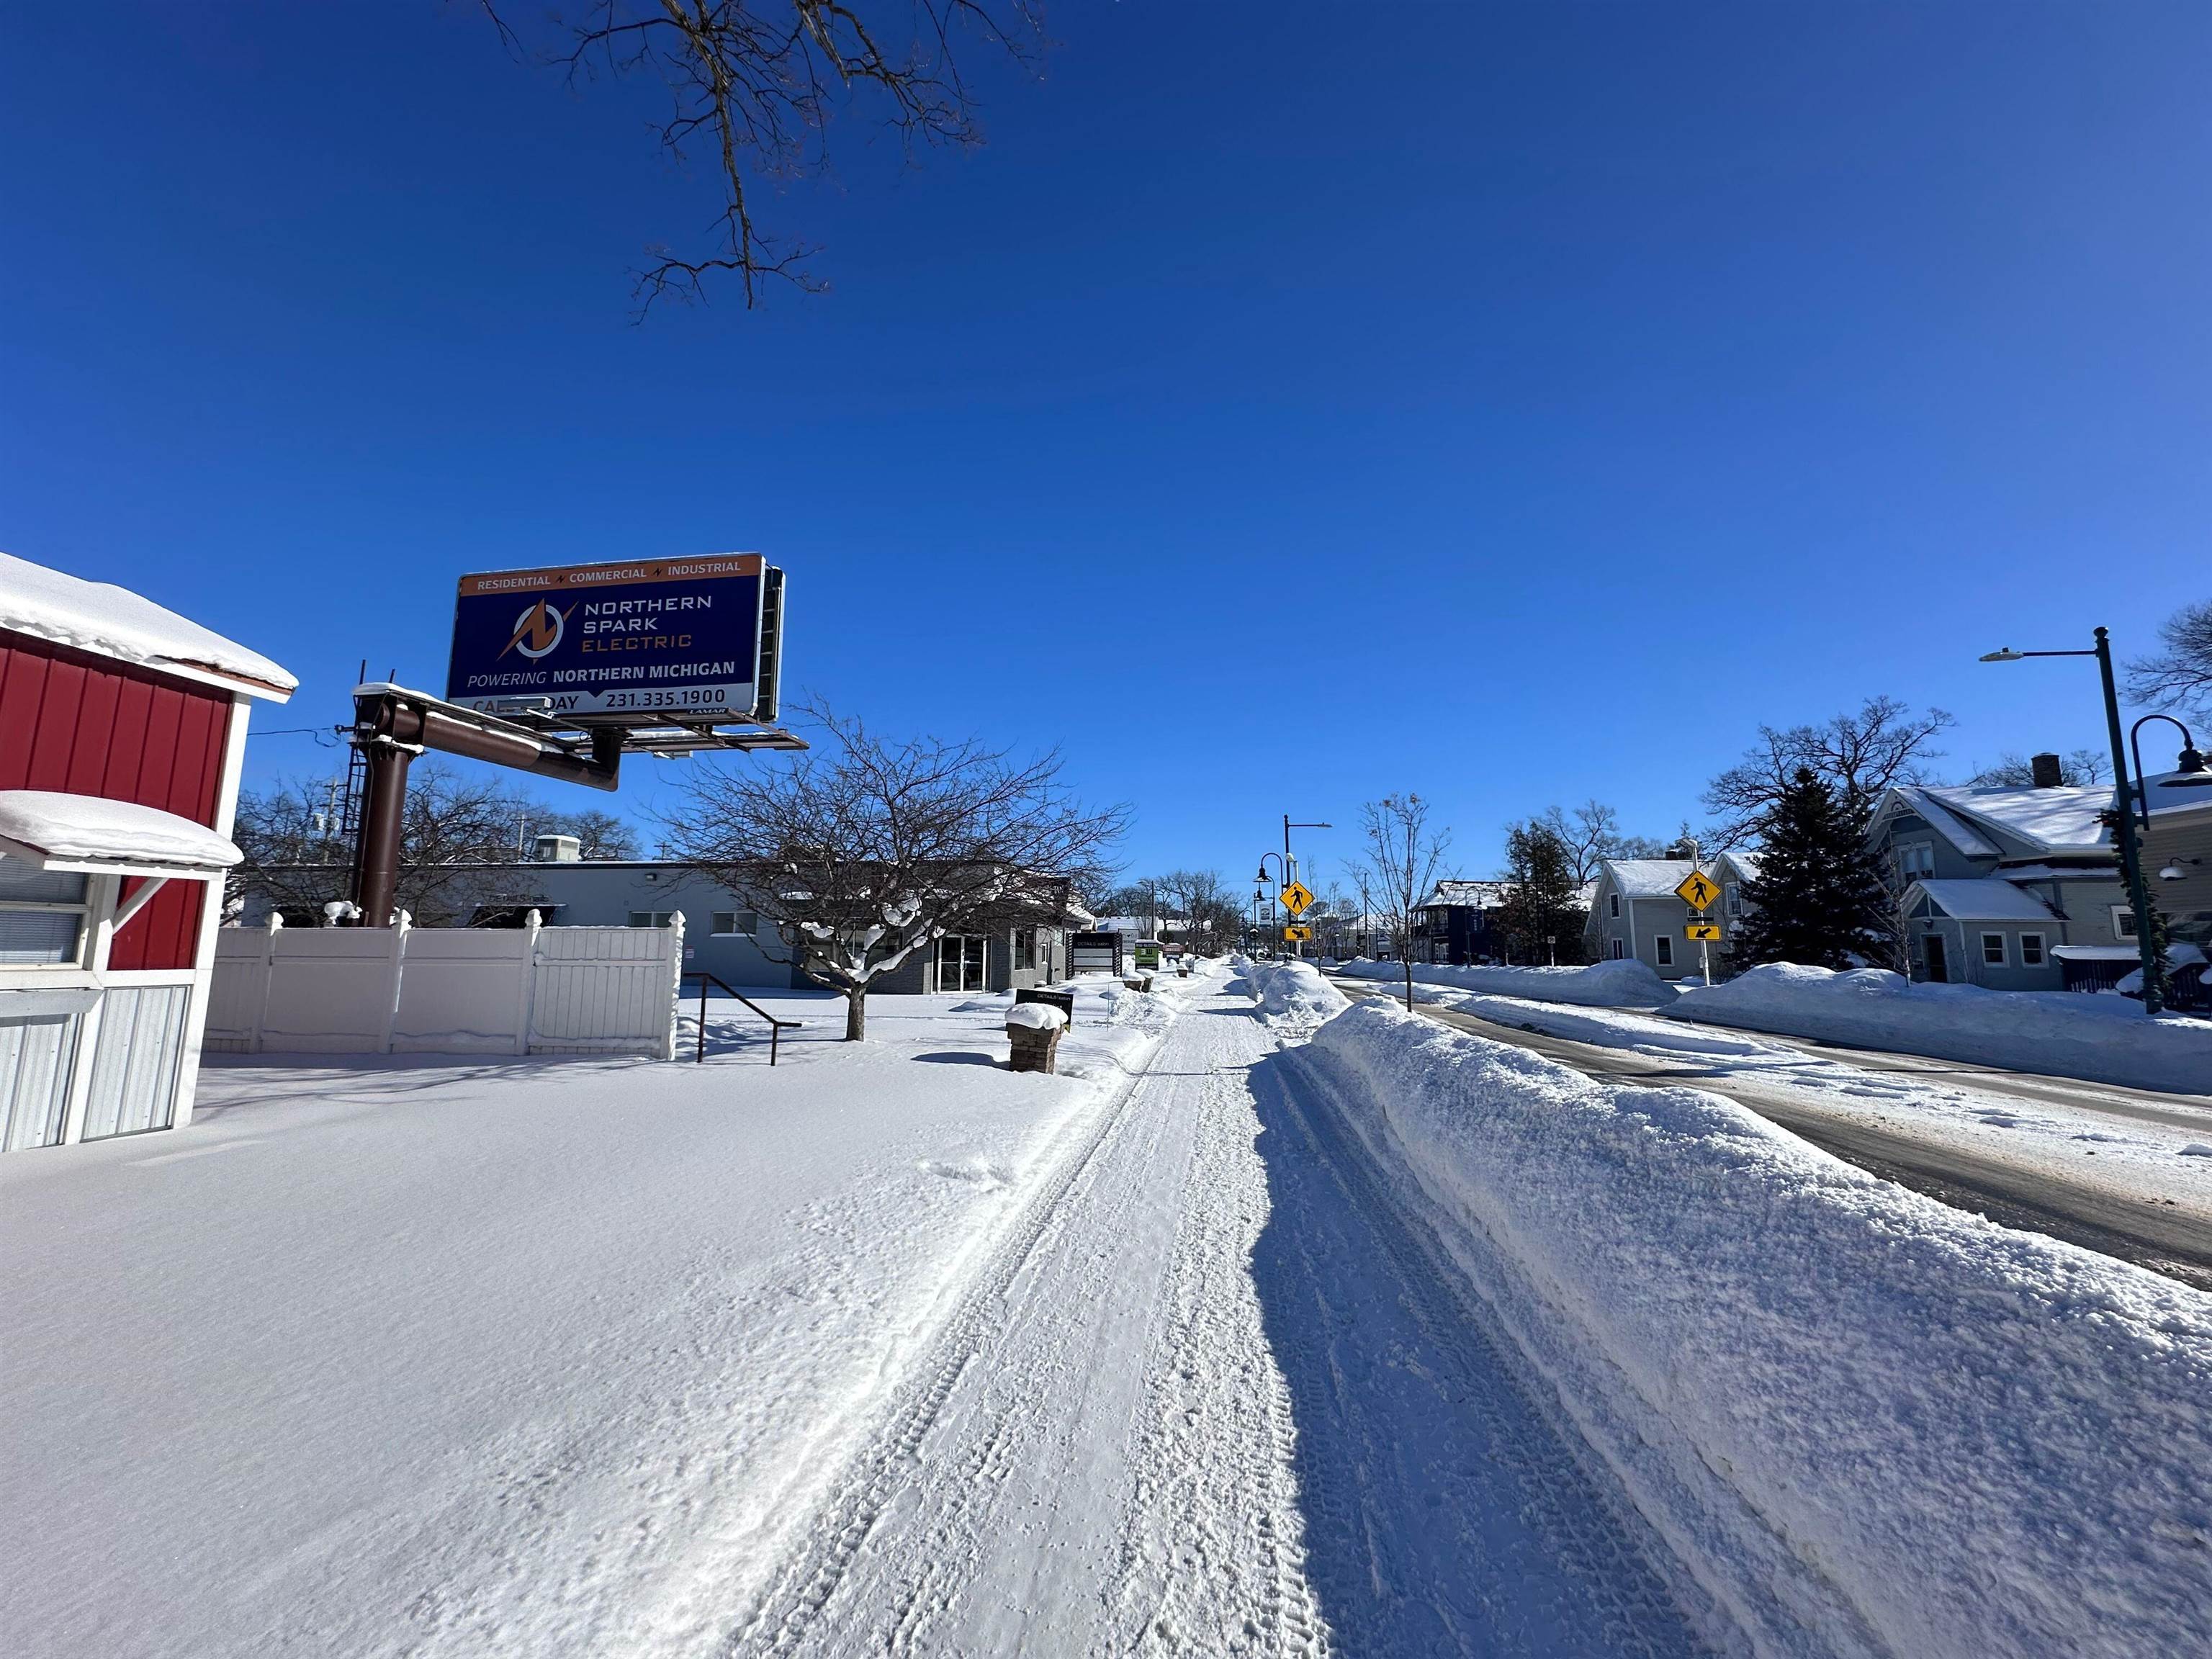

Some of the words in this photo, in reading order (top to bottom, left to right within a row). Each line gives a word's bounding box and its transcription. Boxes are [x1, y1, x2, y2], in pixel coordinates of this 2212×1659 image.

[477, 576, 551, 590] RESIDENTIAL
[570, 569, 647, 583] COMMERCIAL
[667, 562, 741, 575] INDUSTRIAL
[585, 595, 711, 616] NORTHERN
[583, 618, 658, 634] SPARK
[582, 634, 692, 652] ELECTRIC
[467, 672, 547, 688] POWERING
[553, 666, 644, 683] NORTHERN
[649, 661, 735, 678] MICHIGAN
[606, 689, 725, 707] 231.335.1900
